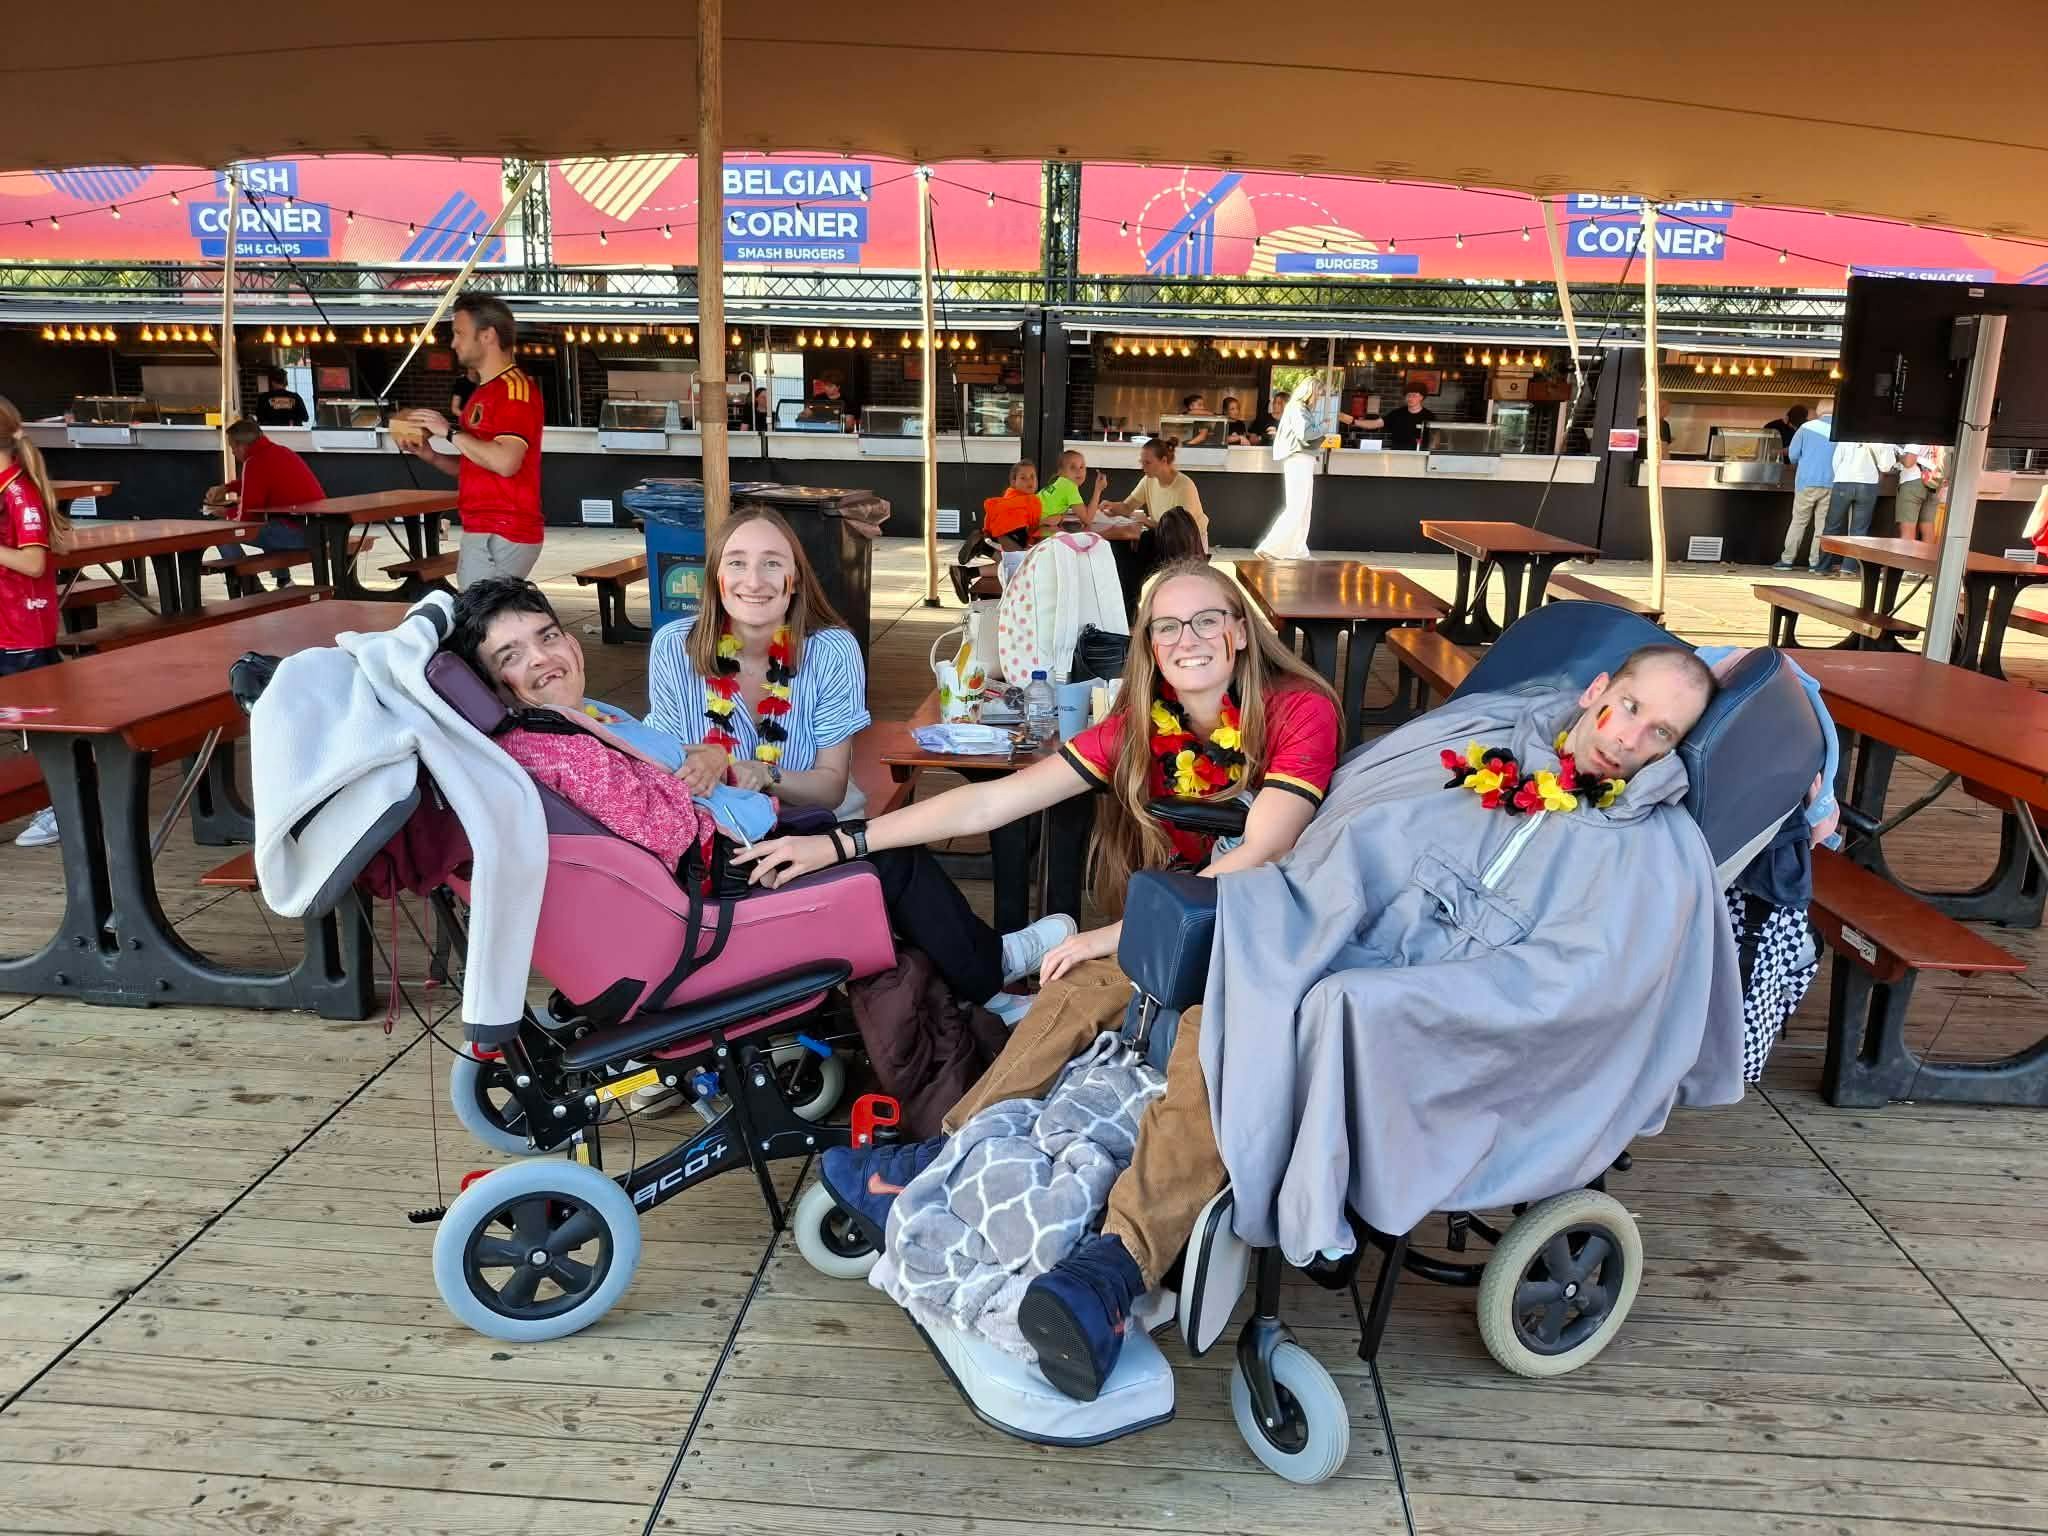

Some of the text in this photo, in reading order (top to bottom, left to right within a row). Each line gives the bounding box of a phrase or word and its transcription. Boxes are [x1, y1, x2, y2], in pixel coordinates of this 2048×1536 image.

[723, 169, 861, 196] BELGIAN
[198, 207, 322, 233] CORNER
[727, 211, 858, 238] CORNER
[255, 244, 264, 254] &
[737, 247, 845, 260] SMASH BURGERS
[1577, 226, 1716, 255] CORNER
[1315, 257, 1379, 270] BURGERS
